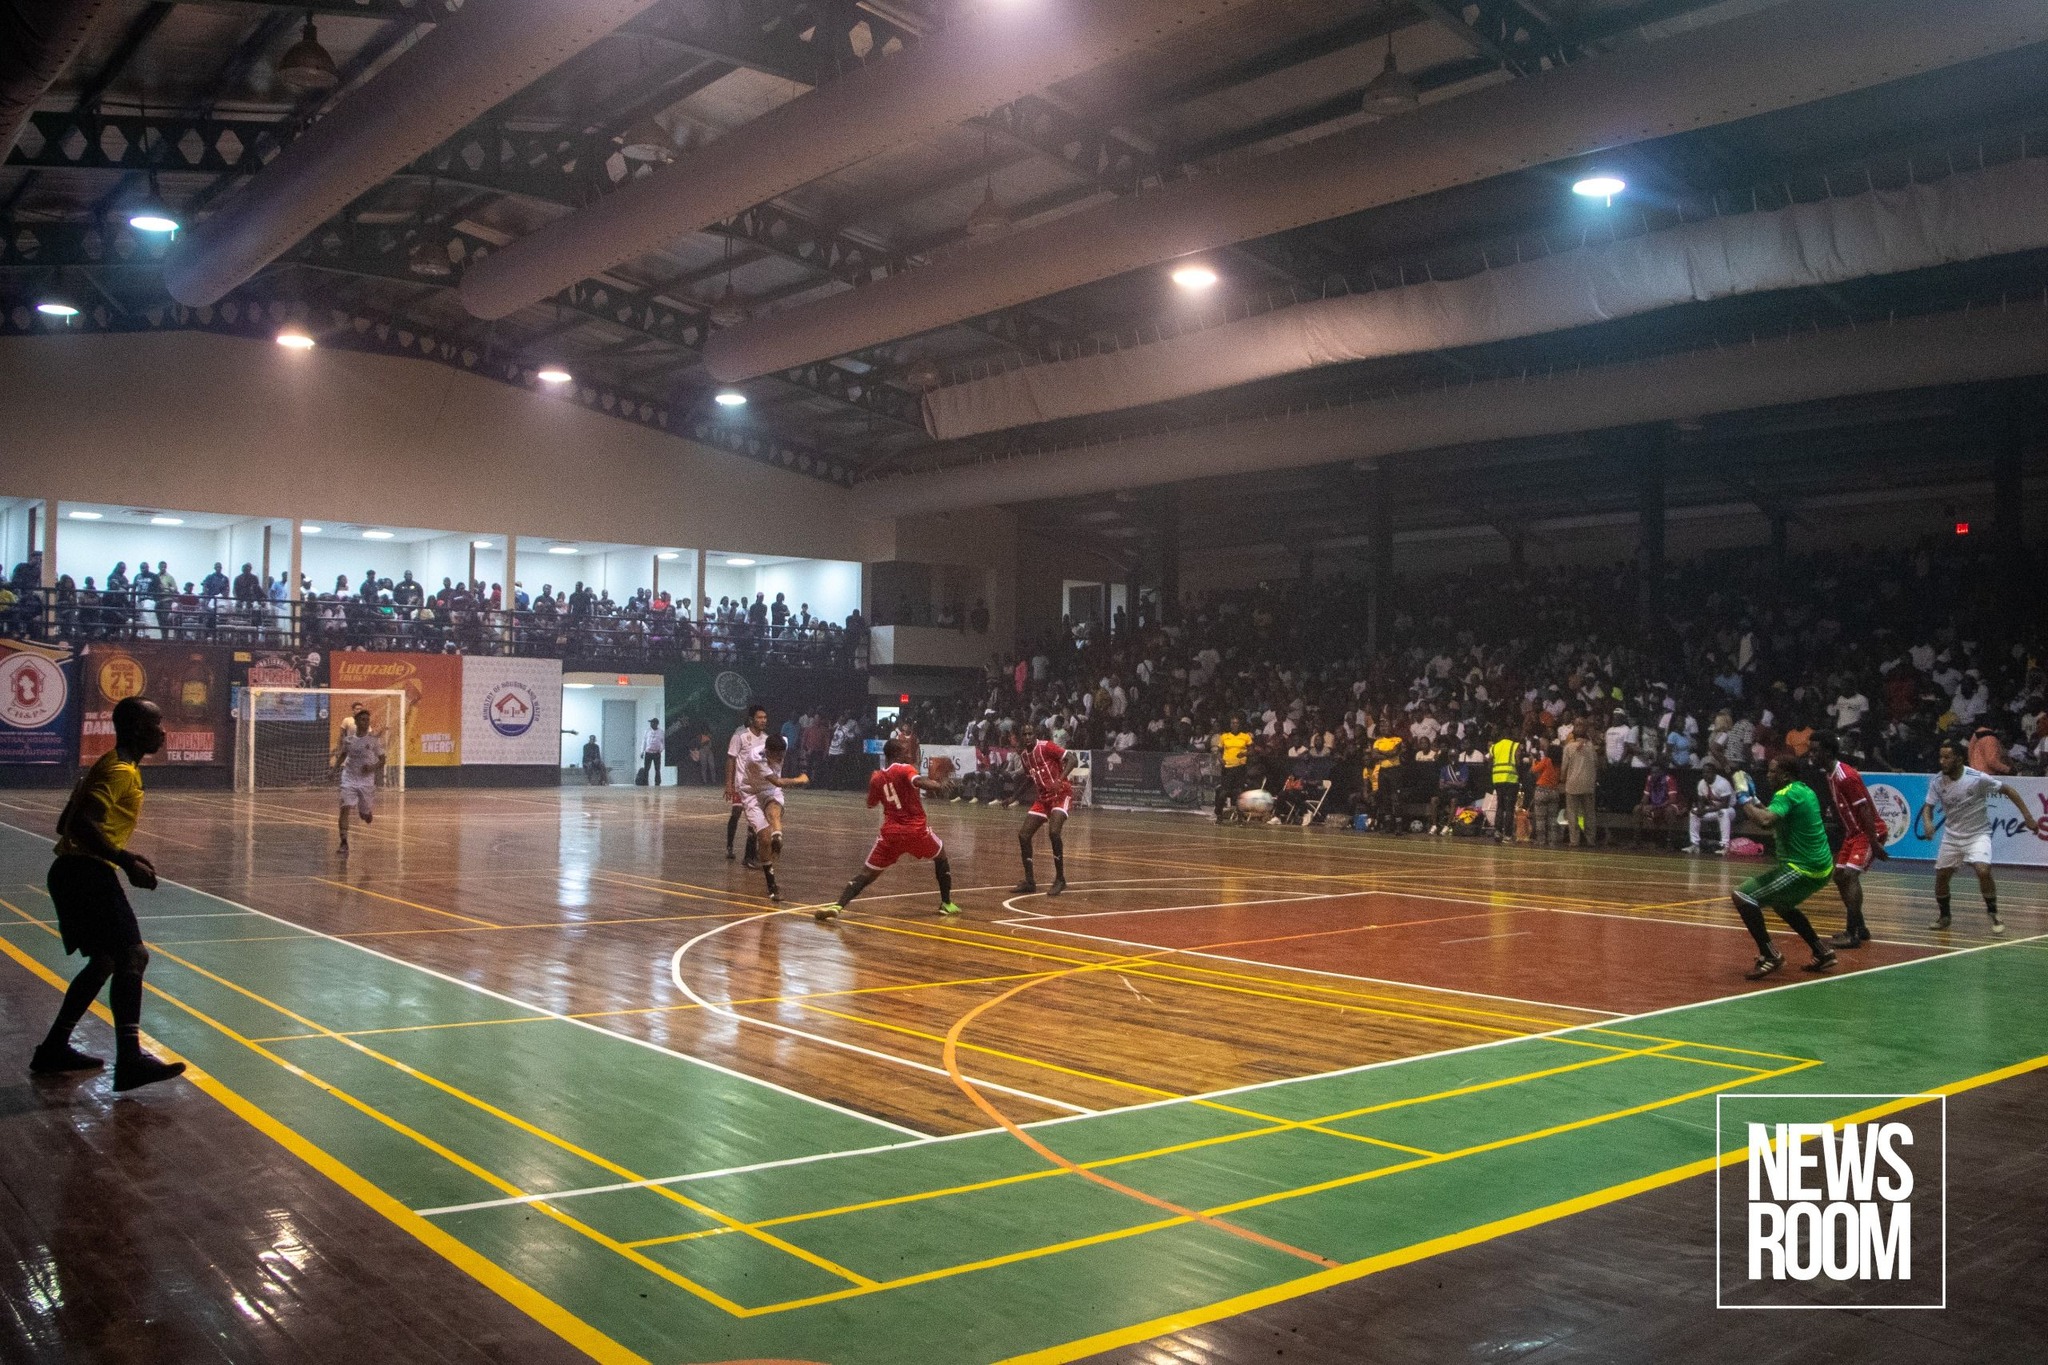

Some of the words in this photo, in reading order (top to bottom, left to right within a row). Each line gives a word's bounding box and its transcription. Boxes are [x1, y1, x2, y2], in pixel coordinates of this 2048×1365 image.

[338, 660, 405, 676] Lucozade
[110, 672, 134, 690] 25
[483, 691, 494, 720] MINISTRY
[883, 782, 902, 810] 4
